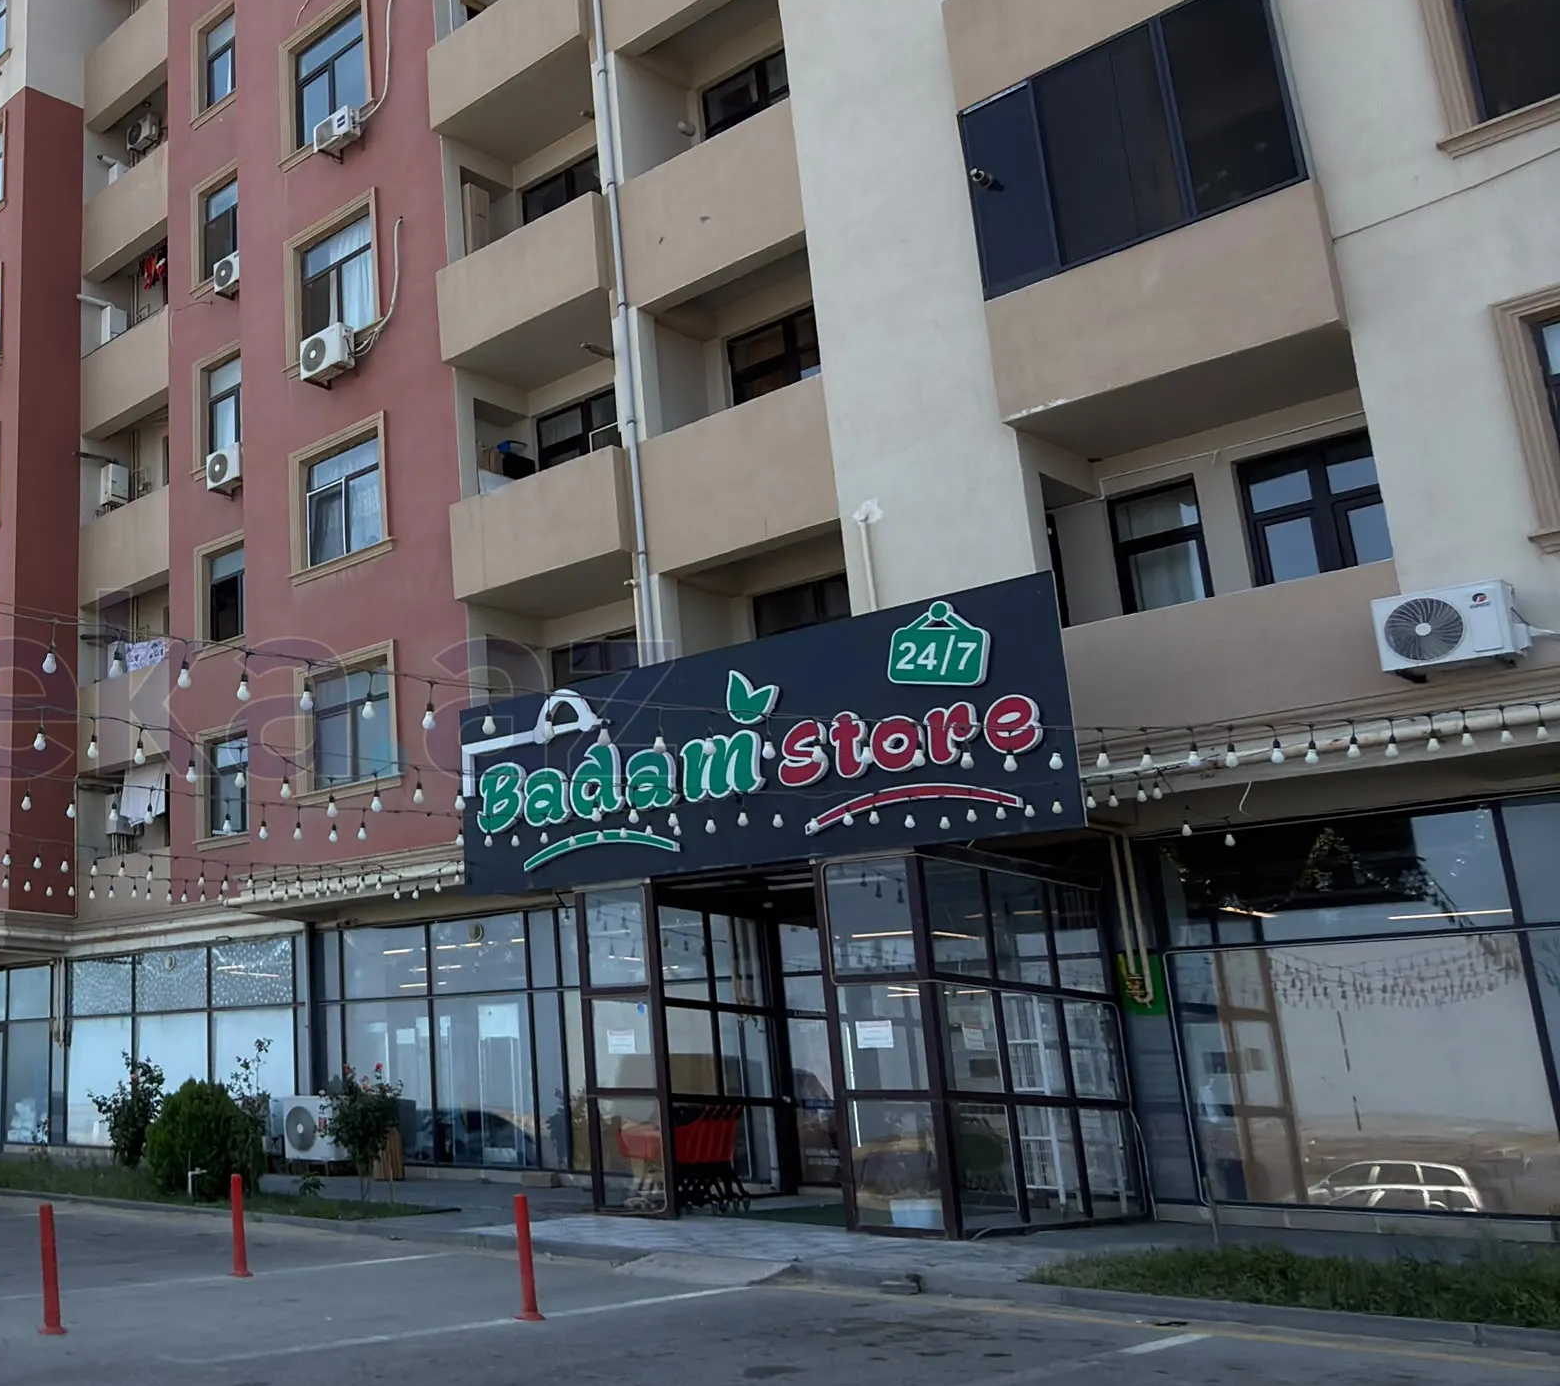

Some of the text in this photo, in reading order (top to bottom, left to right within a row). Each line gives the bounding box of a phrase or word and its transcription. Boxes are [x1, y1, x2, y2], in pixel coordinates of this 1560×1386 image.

[895, 634, 978, 675] 24/7
[477, 694, 1043, 834] Badam store
